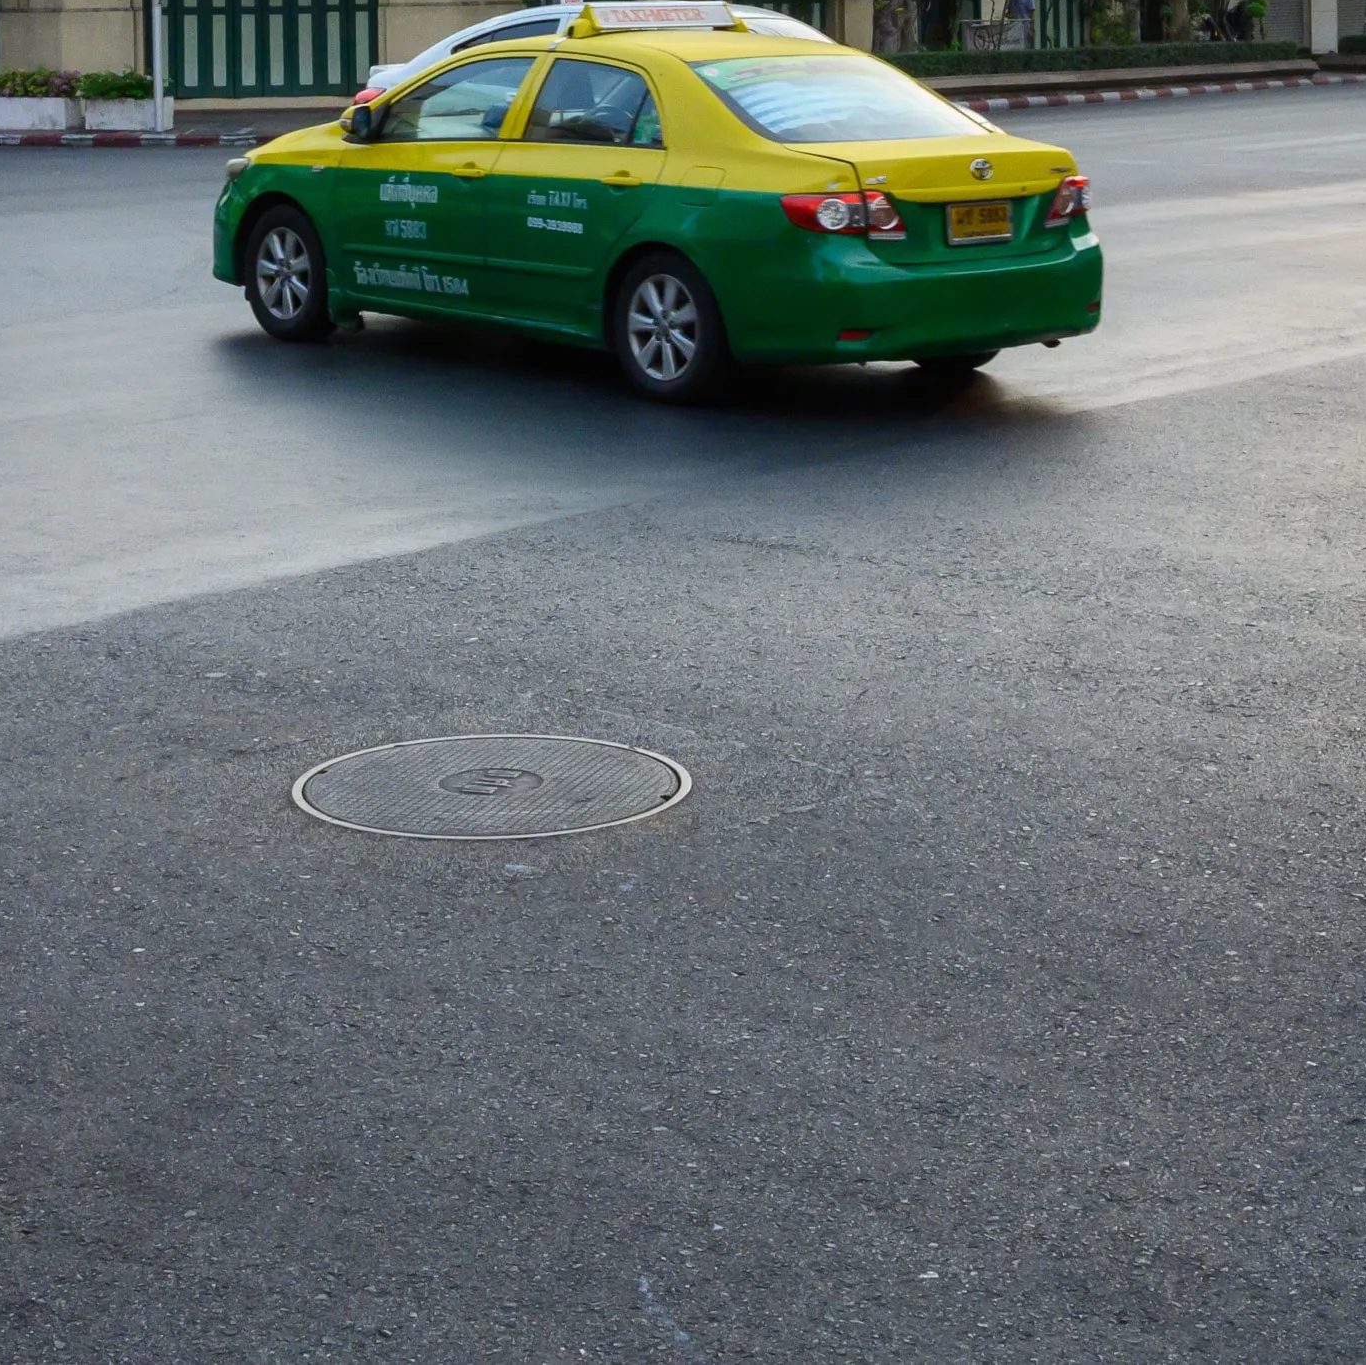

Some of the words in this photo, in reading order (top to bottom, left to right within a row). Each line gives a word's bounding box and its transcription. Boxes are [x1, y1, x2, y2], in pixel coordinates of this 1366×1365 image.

[610, 8, 705, 23] TAXI-METER
[379, 173, 439, 210] แท็กซี่บุคคล
[549, 190, 571, 208] TAXI
